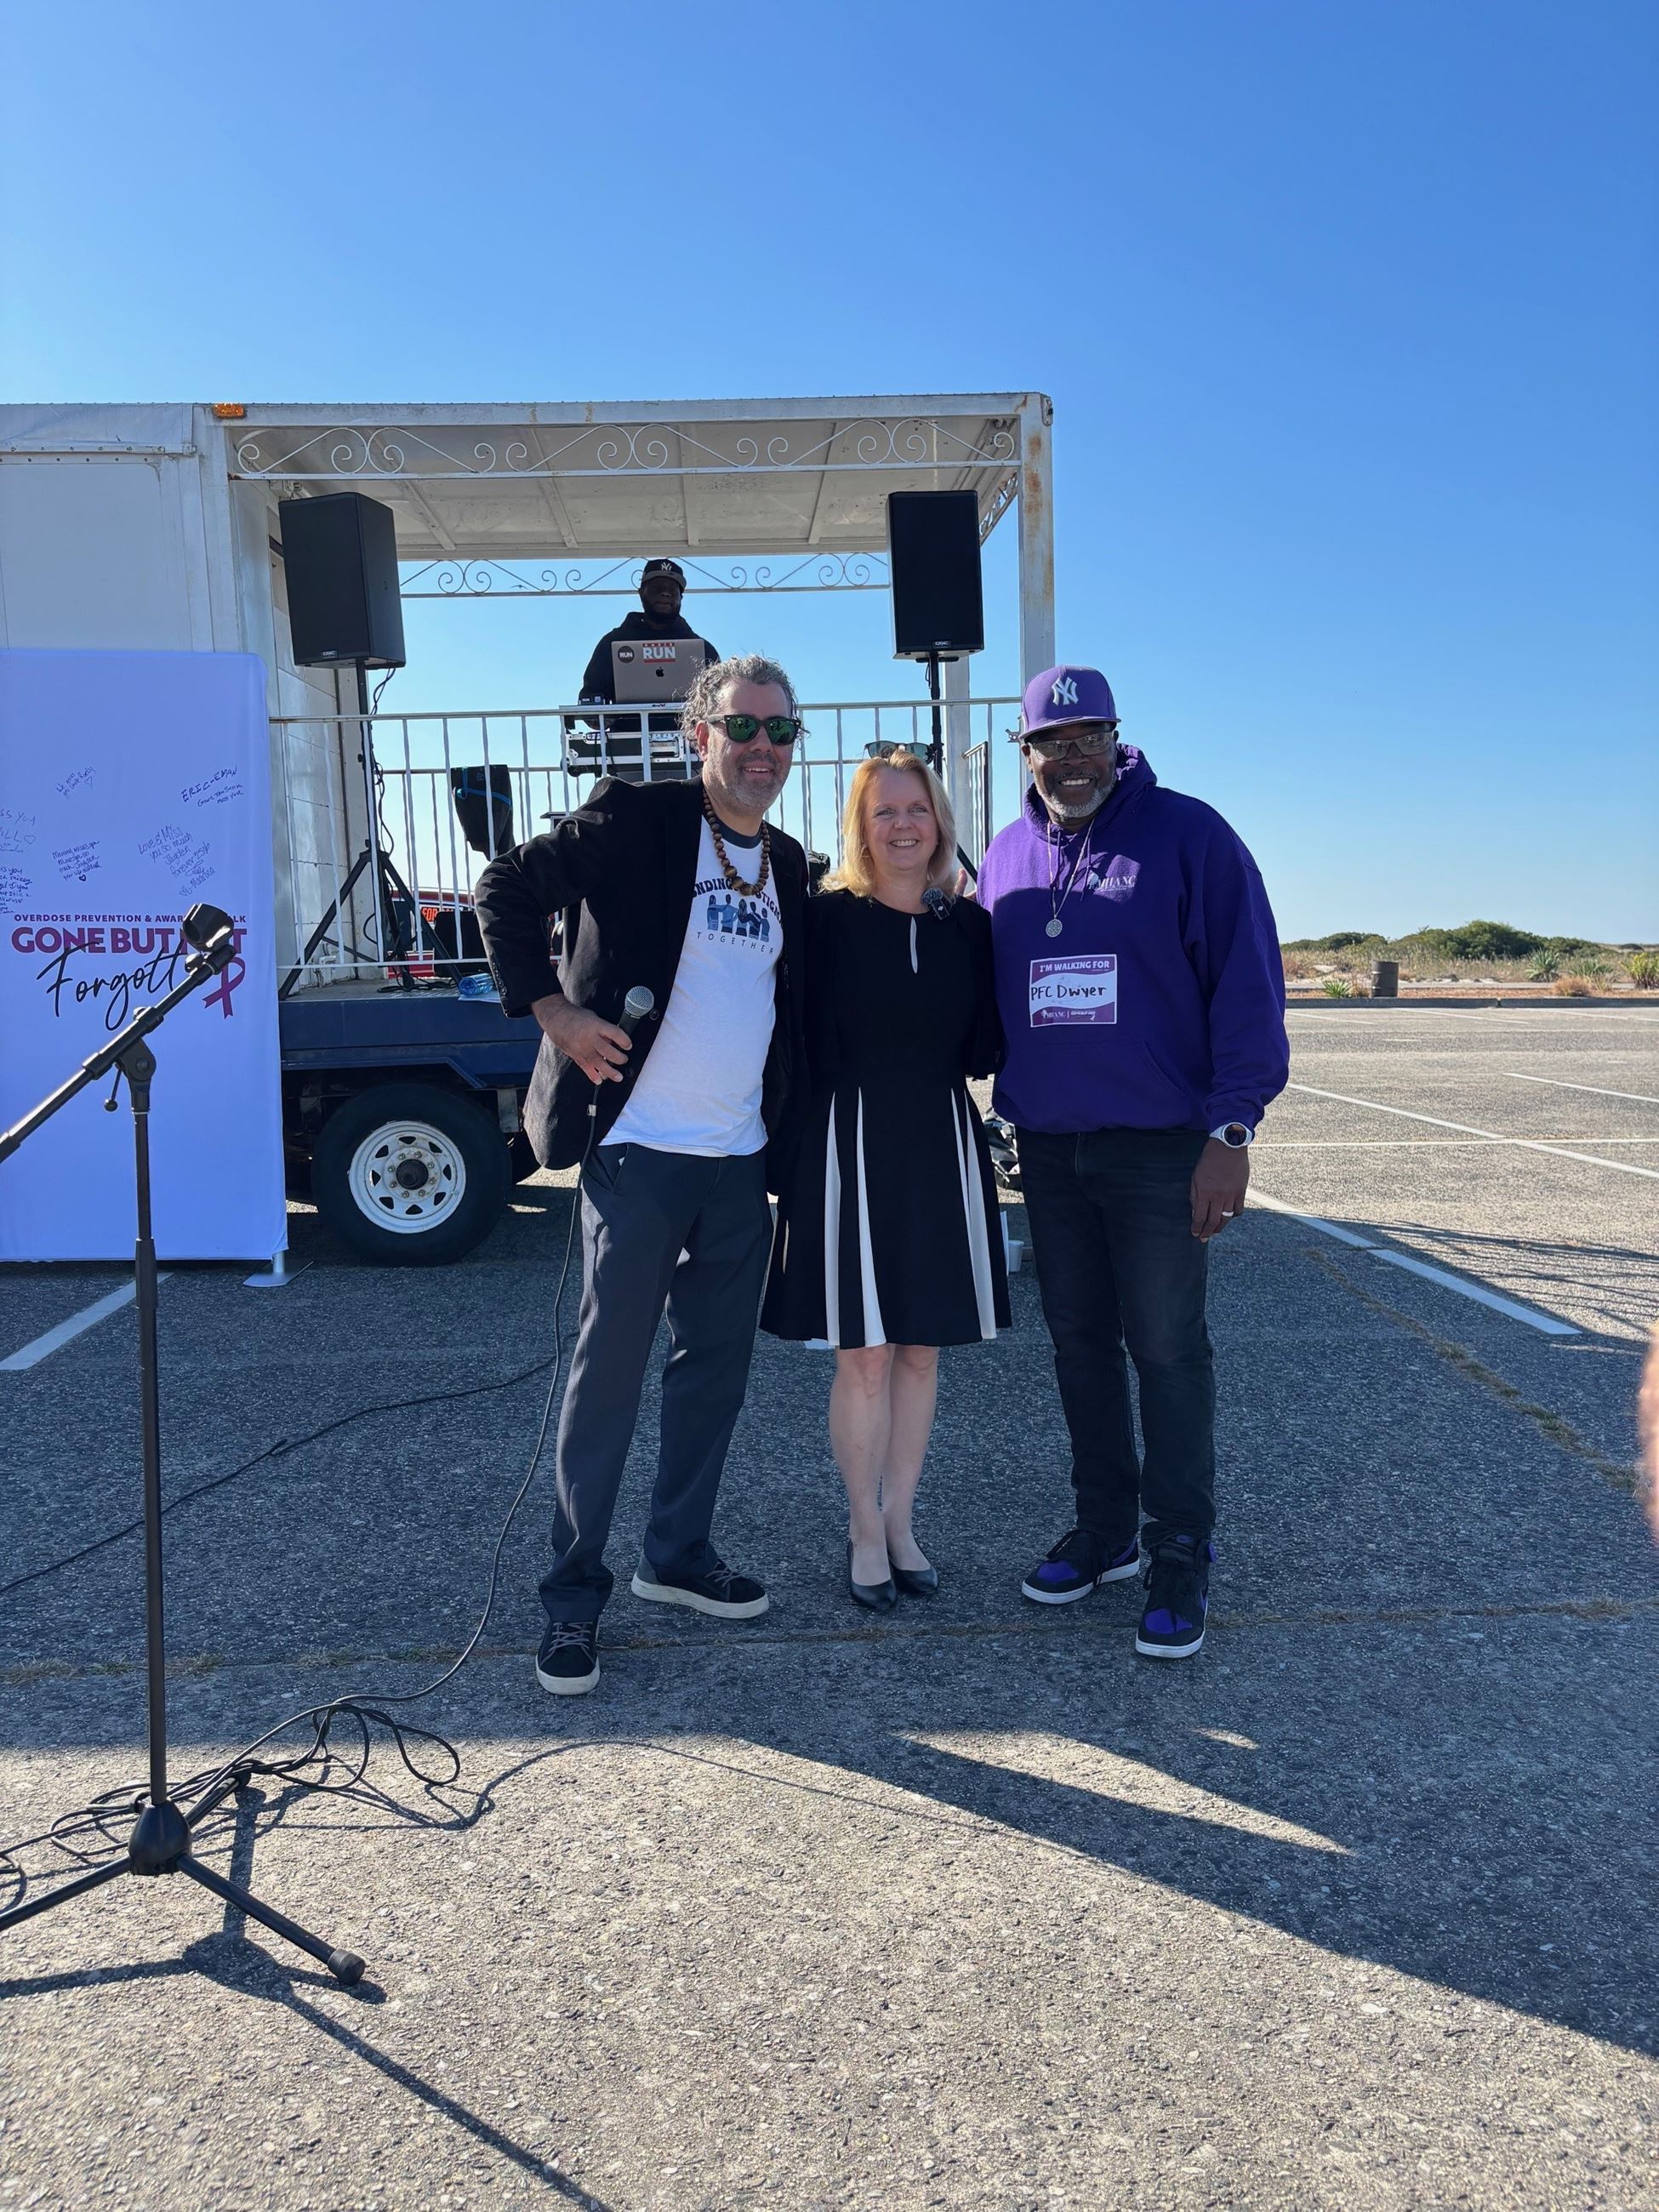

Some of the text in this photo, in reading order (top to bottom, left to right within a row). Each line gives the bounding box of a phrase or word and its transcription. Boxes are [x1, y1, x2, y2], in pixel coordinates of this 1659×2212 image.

[642, 647, 676, 659] RUN
[1051, 676, 1079, 706] NY
[693, 878, 733, 898] NDING
[14, 914, 71, 922] OVERDOSE
[11, 926, 106, 954] GONE
[111, 927, 175, 954] BUT
[697, 932, 774, 955] TOGETHER
[1040, 961, 1110, 972] I'M WALKING FOR
[37, 940, 188, 1031] Forgott
[1031, 984, 1107, 1001] PFC Dwyer
